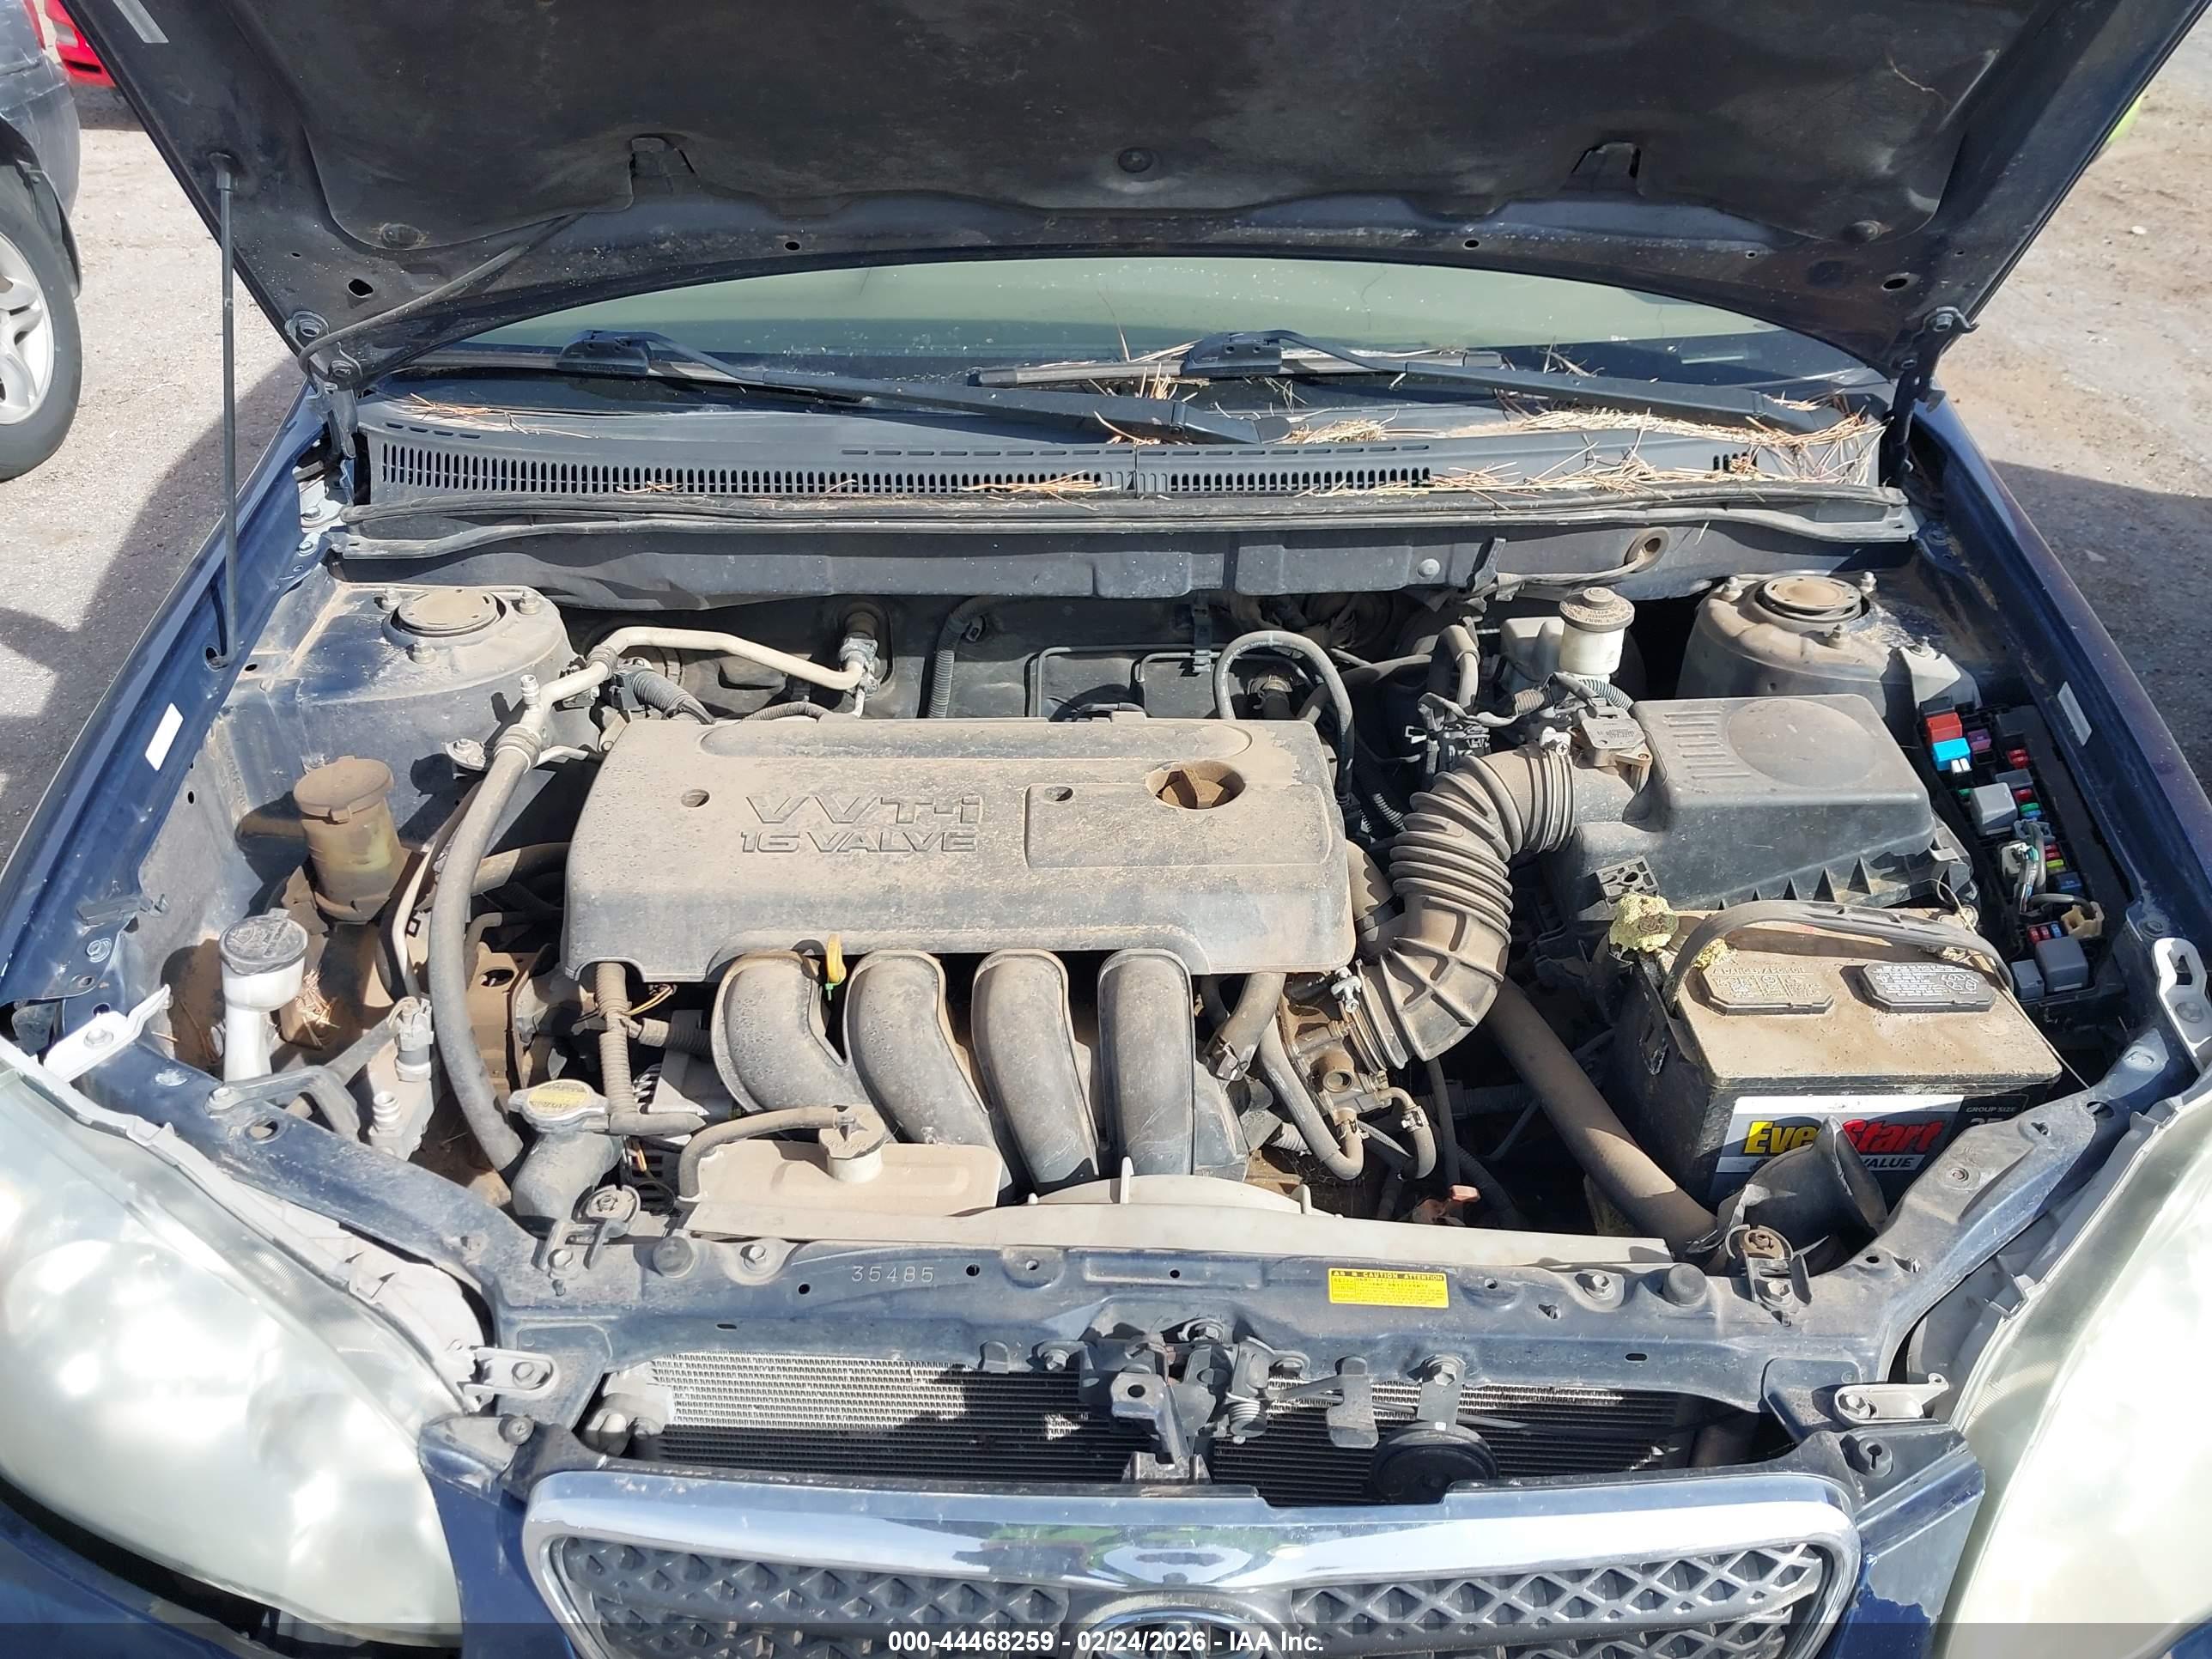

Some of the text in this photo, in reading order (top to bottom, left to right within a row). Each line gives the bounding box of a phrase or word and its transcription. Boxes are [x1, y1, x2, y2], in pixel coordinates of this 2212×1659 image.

[745, 796, 981, 824] VVT-i
[740, 831, 978, 853] 16 VALVE
[851, 1266, 934, 1283] 35485
[1363, 1270, 1398, 1279] CAUTION
